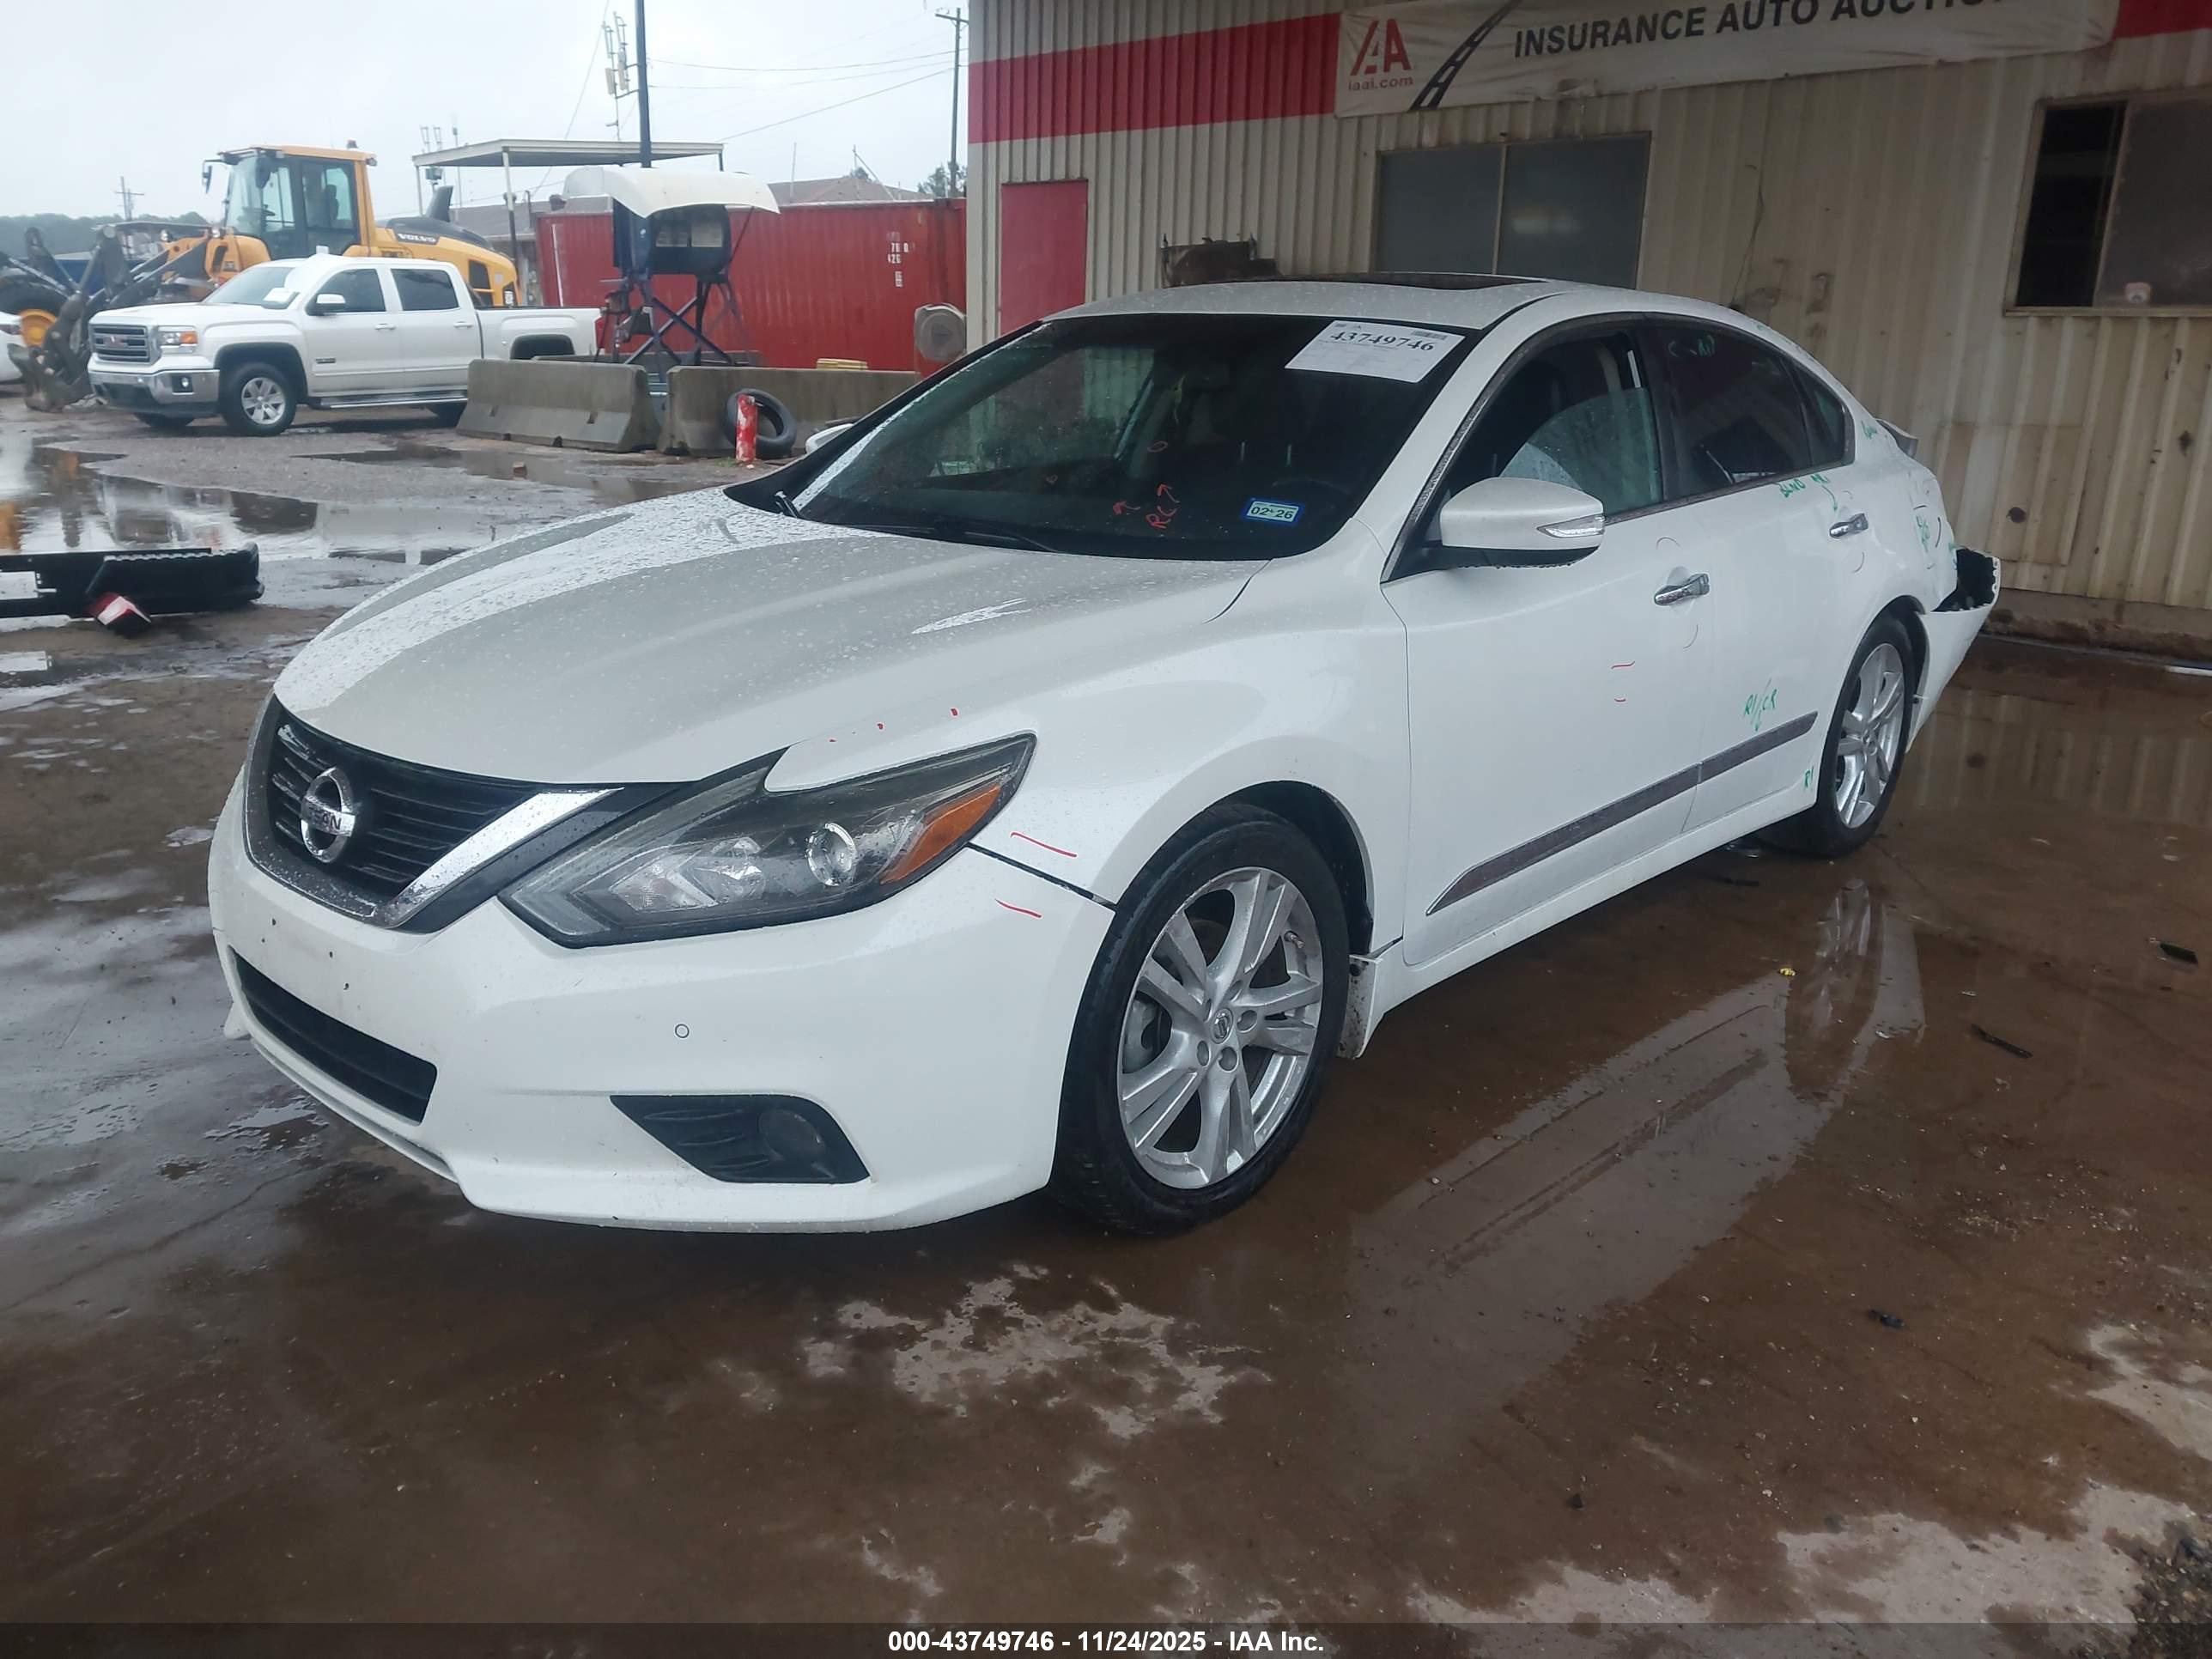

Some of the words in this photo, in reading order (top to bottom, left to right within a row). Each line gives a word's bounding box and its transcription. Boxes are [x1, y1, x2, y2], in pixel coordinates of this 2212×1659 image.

[1515, 7, 1706, 58] INSURANCE
[1716, 0, 1818, 33] AUTO
[1348, 76, 1413, 91] iaai.com
[398, 233, 436, 243] VOLVO
[1330, 331, 1434, 351] 43749746
[1251, 507, 1270, 516] 02
[1274, 509, 1294, 520] 26
